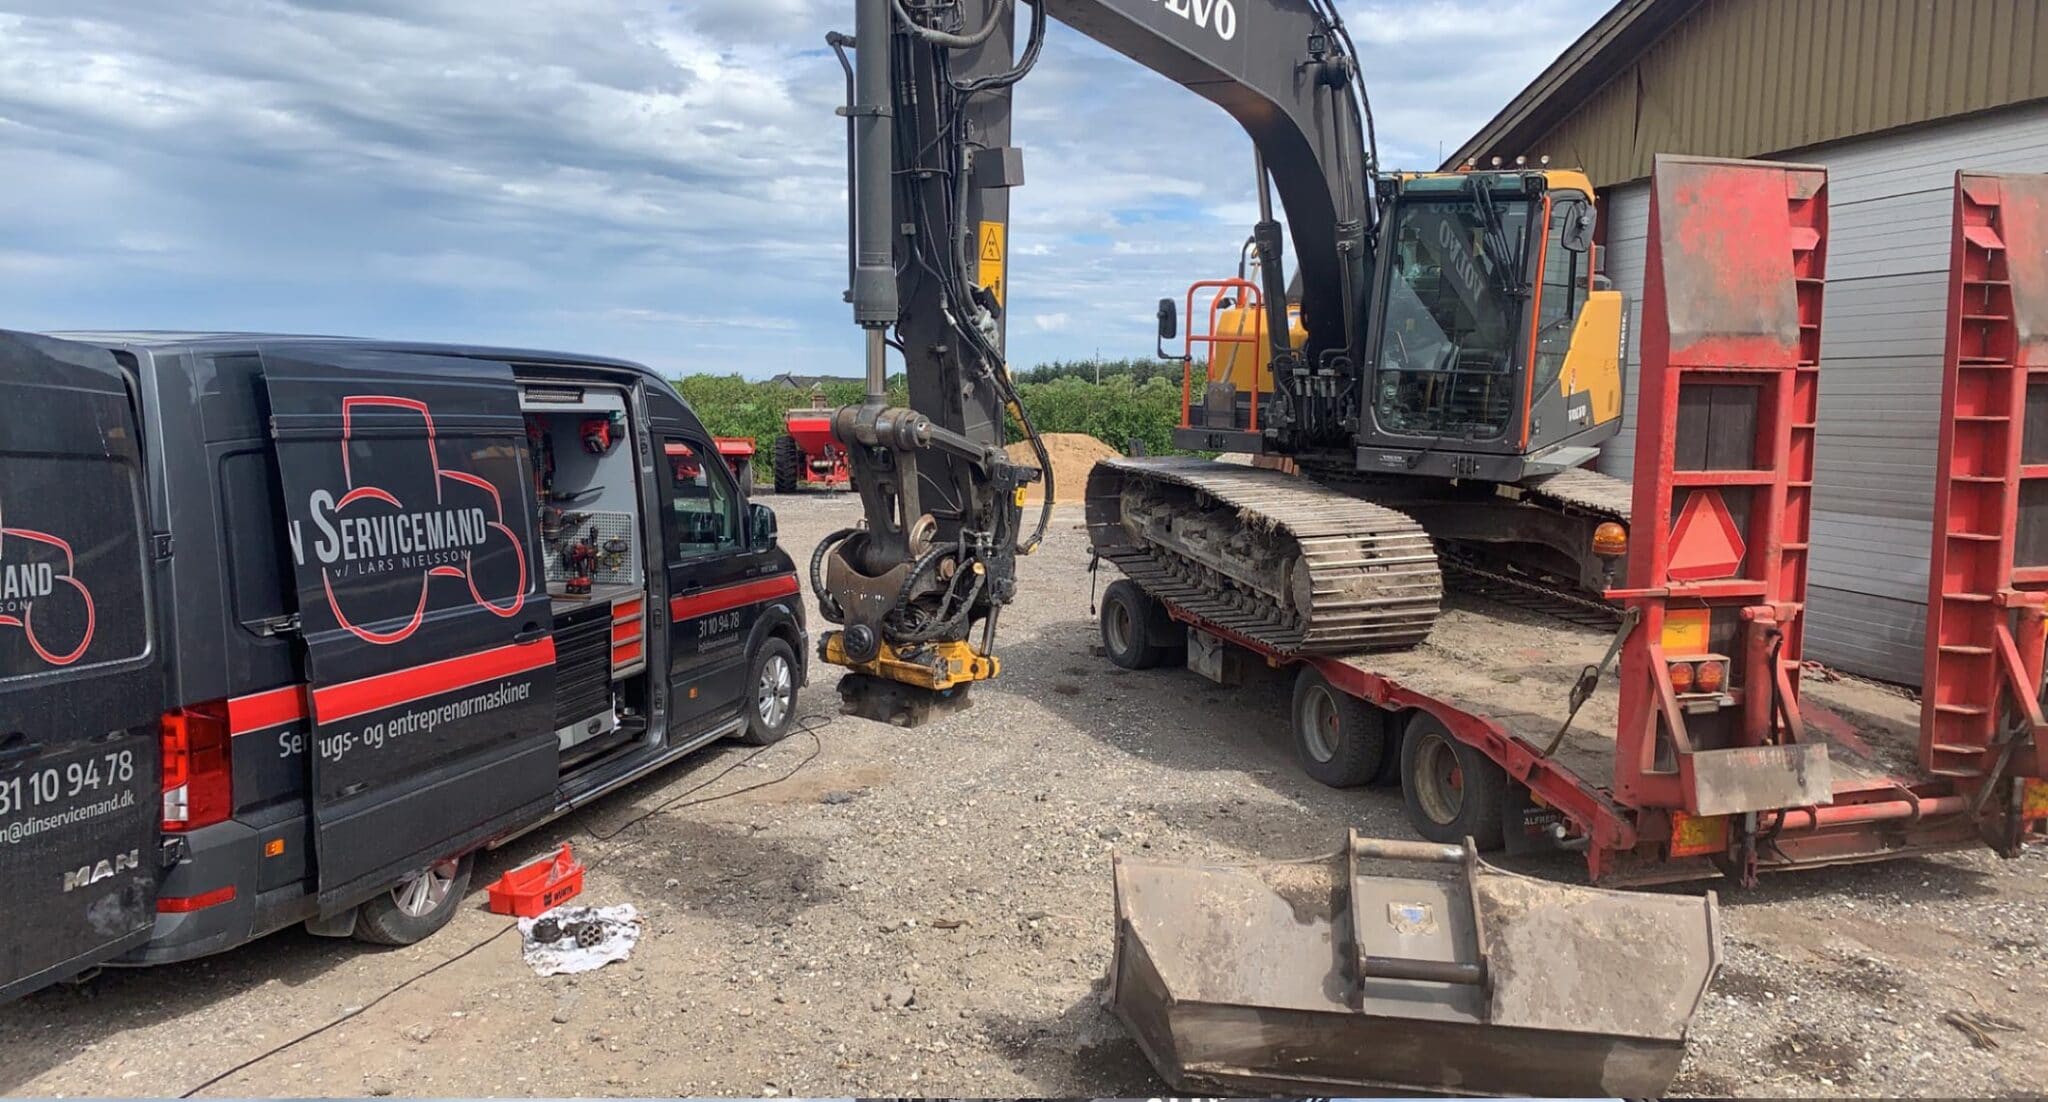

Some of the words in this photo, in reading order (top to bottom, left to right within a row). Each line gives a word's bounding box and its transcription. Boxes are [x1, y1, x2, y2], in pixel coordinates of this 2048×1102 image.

[310, 489, 487, 563] SERVICEMAND
[0, 563, 52, 600] AND
[358, 558, 394, 575] LARS
[402, 549, 469, 569] NIELSSON
[698, 619, 707, 638] 31
[708, 617, 717, 634] 10
[718, 614, 729, 632] 94
[730, 611, 740, 629] 78
[318, 735, 359, 762] ugs-
[363, 724, 384, 749] og
[388, 681, 532, 738] entreprenørmaskiner
[0, 776, 21, 816] 31
[29, 768, 60, 806] 10
[66, 759, 101, 797] 94
[105, 750, 134, 786] 78
[63, 849, 139, 893] MAN
